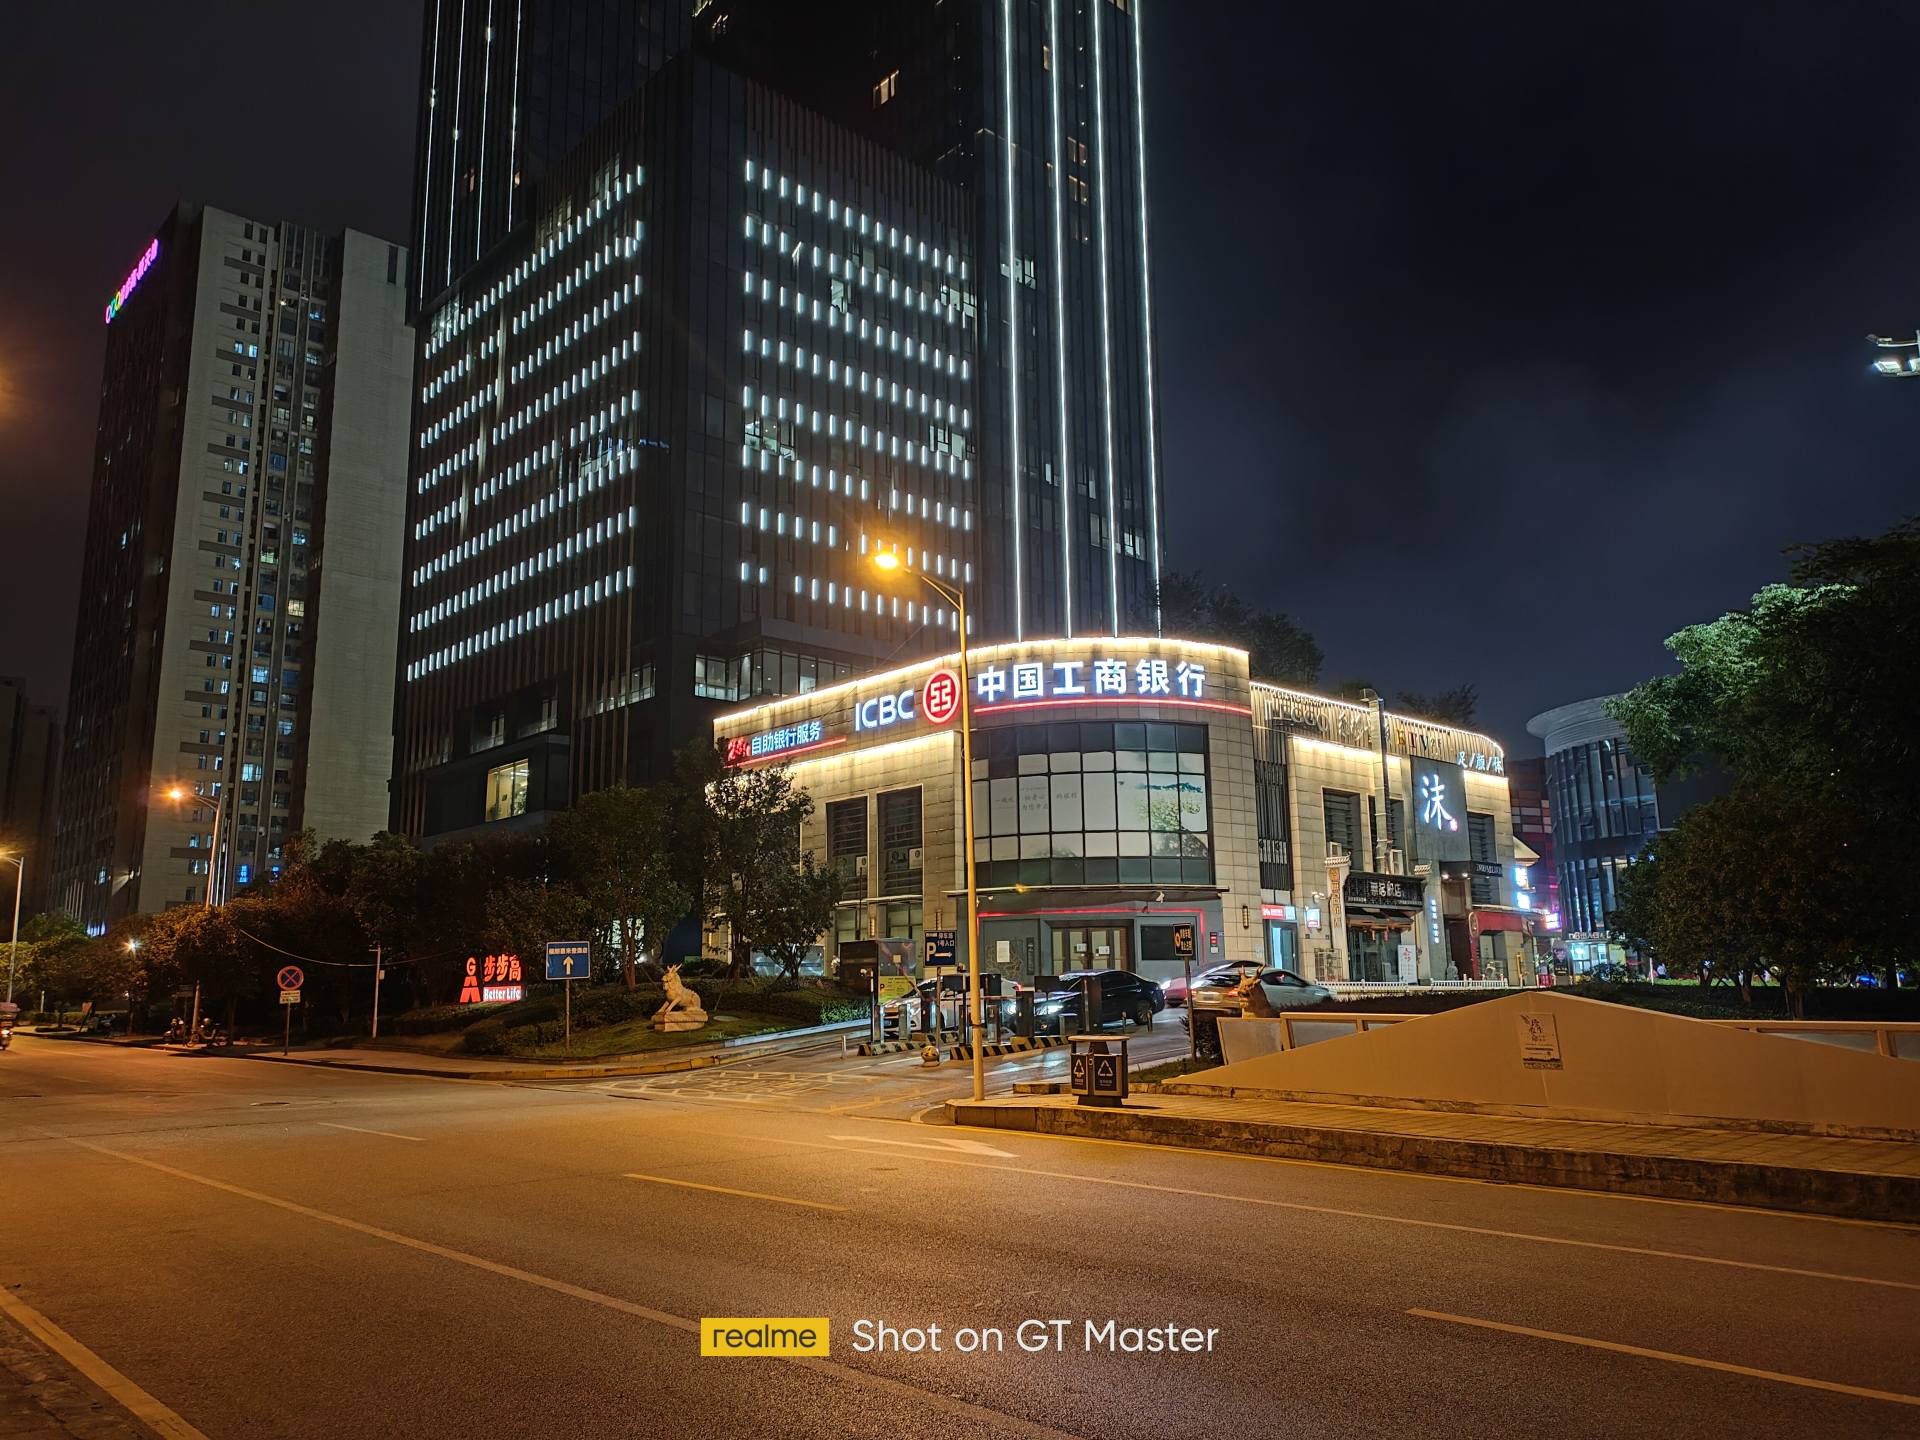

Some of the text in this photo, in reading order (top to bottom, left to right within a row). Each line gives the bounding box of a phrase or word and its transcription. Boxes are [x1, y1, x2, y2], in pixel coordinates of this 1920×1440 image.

[977, 659, 1206, 702] 中国工商银行
[855, 689, 915, 731] ICBC
[751, 721, 822, 756] 自助银行服务
[484, 953, 521, 982] 步步高
[926, 942, 937, 962] P
[483, 986, 520, 1001] Better Life
